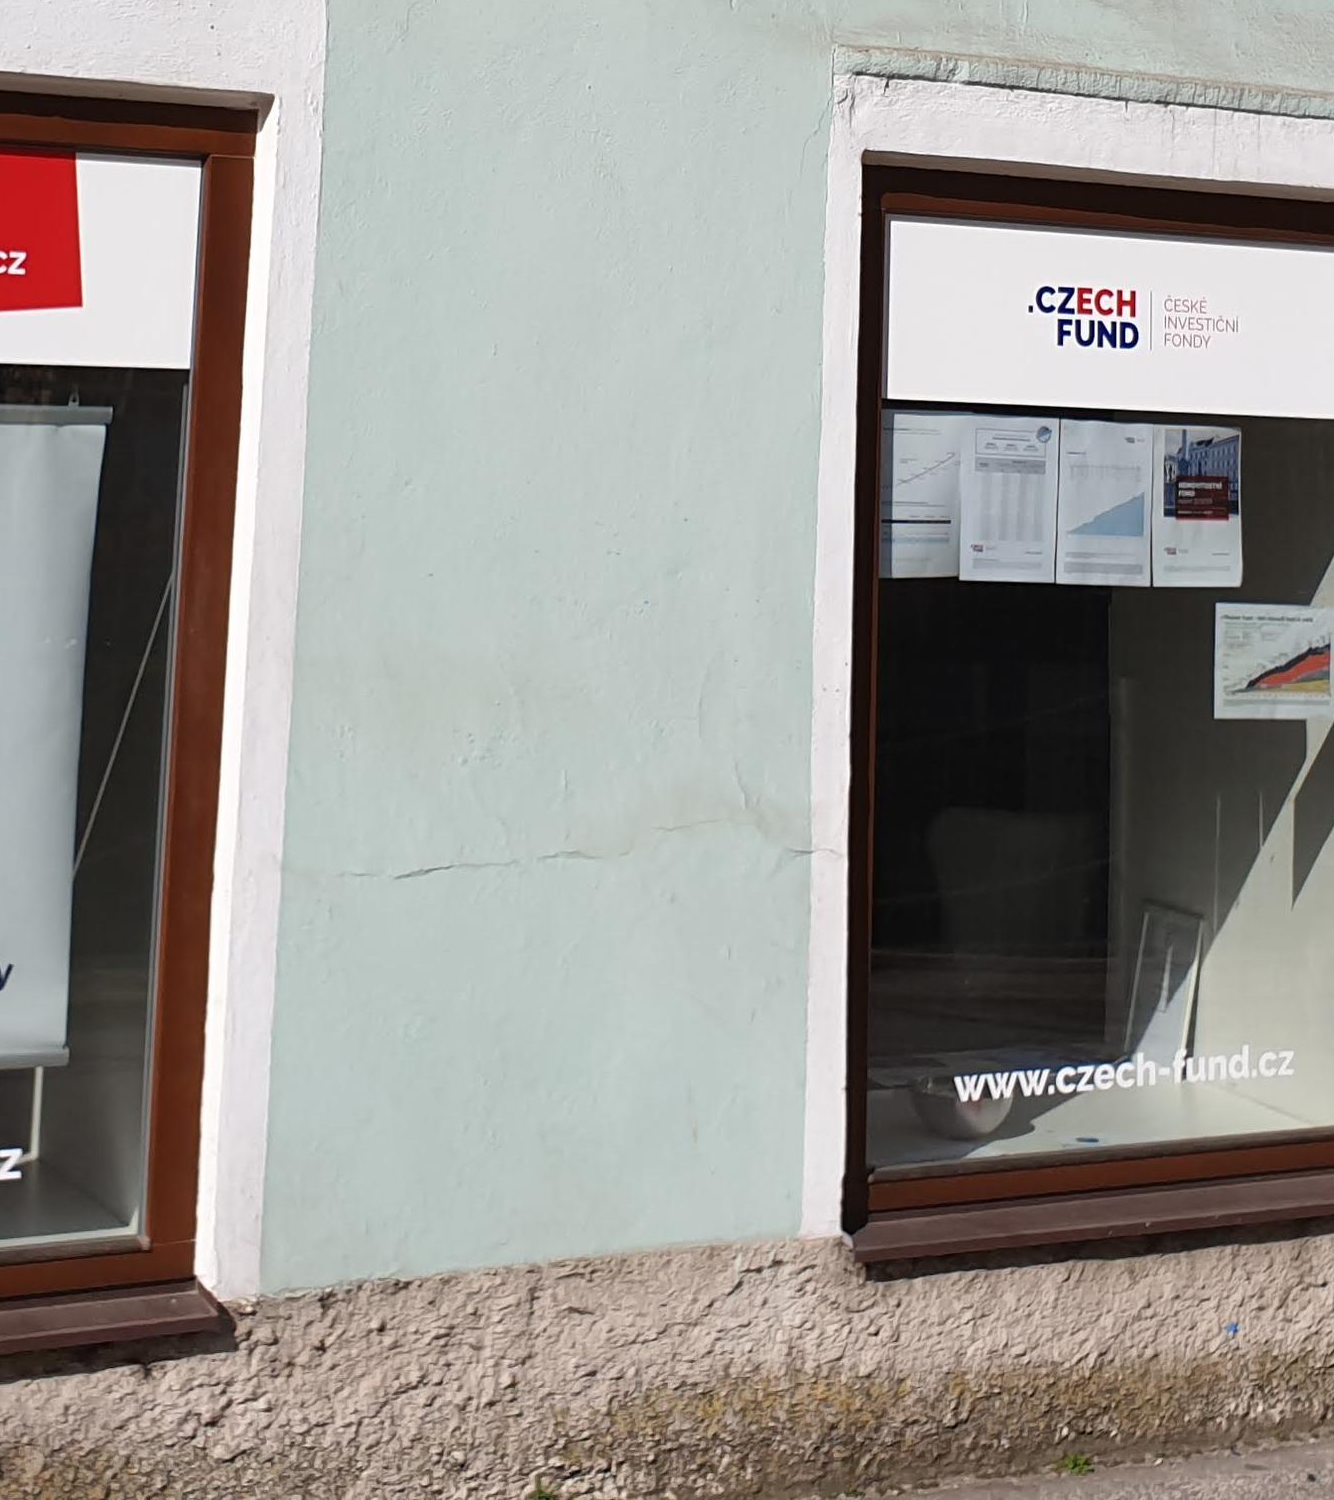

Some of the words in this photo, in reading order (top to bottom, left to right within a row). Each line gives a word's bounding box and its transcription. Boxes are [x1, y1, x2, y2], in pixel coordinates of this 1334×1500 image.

[1164, 295, 1207, 314] ČESKÉ
[1057, 319, 1139, 349] FUND
[1164, 316, 1239, 333] INVESTIČNÍ
[1164, 333, 1211, 348] FONDY
[954, 1045, 1294, 1103] www.czech-fund.cz
